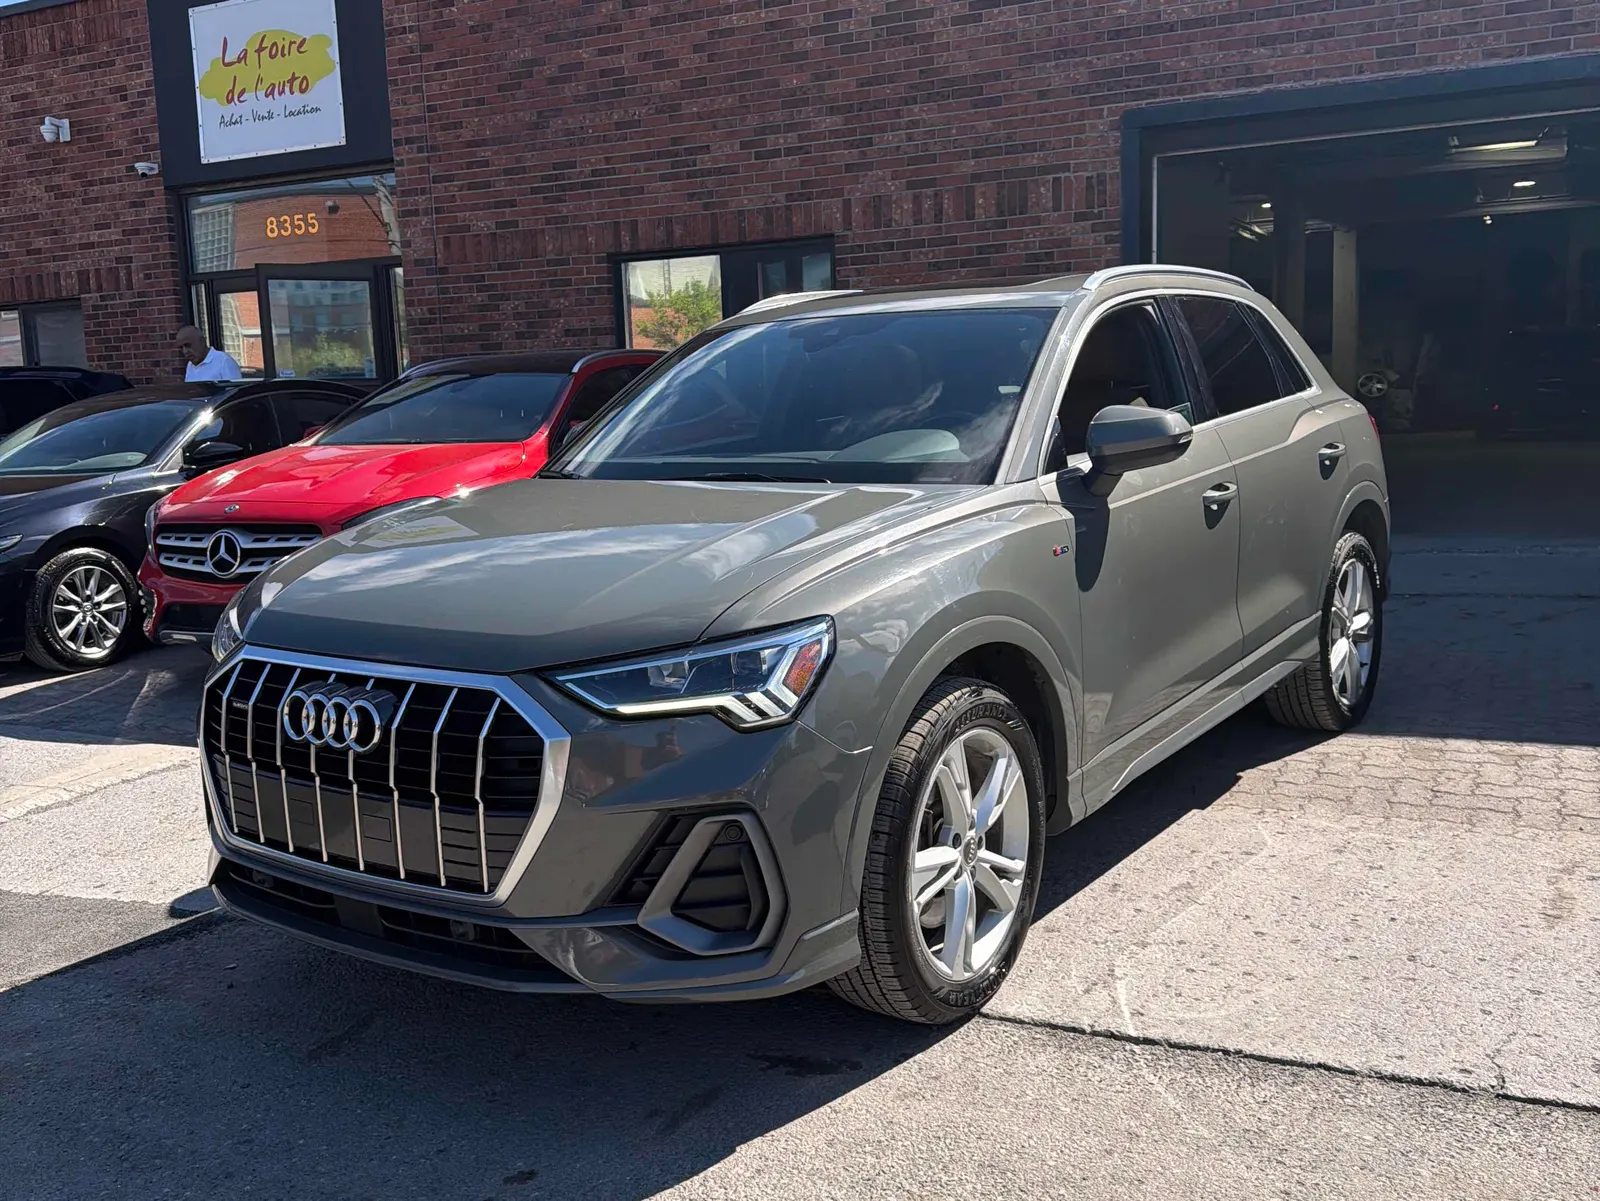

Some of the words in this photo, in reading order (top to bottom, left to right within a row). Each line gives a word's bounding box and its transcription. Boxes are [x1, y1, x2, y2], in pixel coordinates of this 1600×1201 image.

[222, 36, 248, 67] La
[254, 34, 308, 70] foire
[226, 75, 247, 106] de
[255, 71, 309, 101] l'auto
[219, 112, 243, 129] Achat
[251, 108, 274, 123] Vente
[284, 104, 322, 119] Location
[266, 212, 319, 238] 8355
